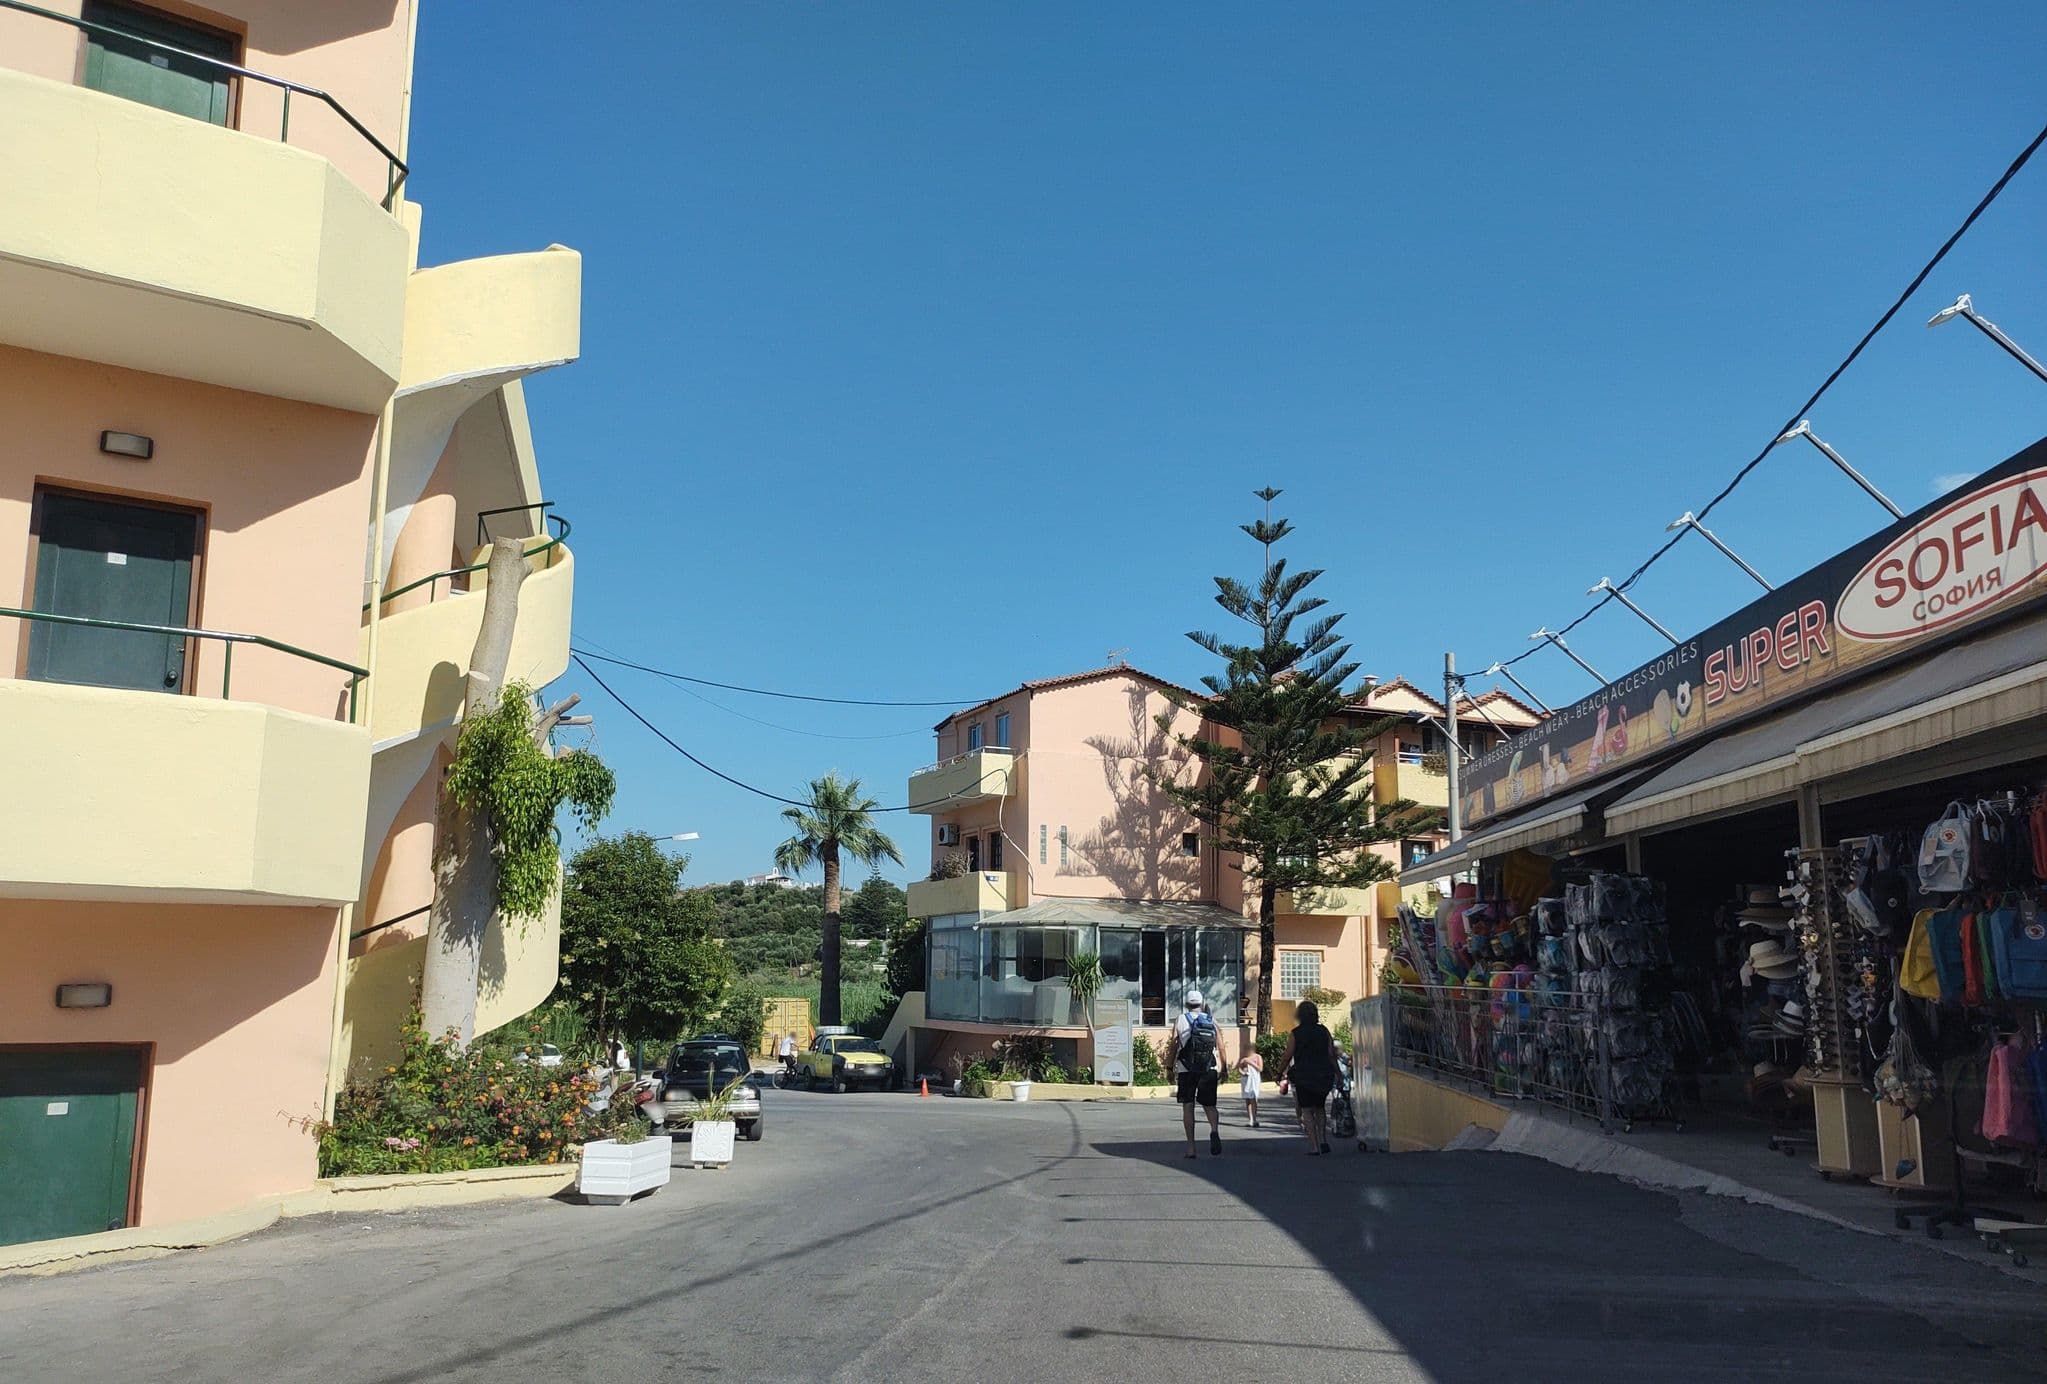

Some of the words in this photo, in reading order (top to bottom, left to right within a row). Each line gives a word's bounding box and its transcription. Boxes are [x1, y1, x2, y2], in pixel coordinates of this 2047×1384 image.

[1874, 487, 2047, 609] SOFIA
[1912, 566, 2001, 621] СОФИЯ
[1483, 742, 1514, 768] DRESSES
[1519, 728, 1544, 749] BEACH
[1545, 715, 1569, 734] WEAR
[1576, 691, 1609, 719] BEACH
[1611, 641, 1697, 701] ACCESSORIES
[1704, 599, 1830, 705] SUPER
